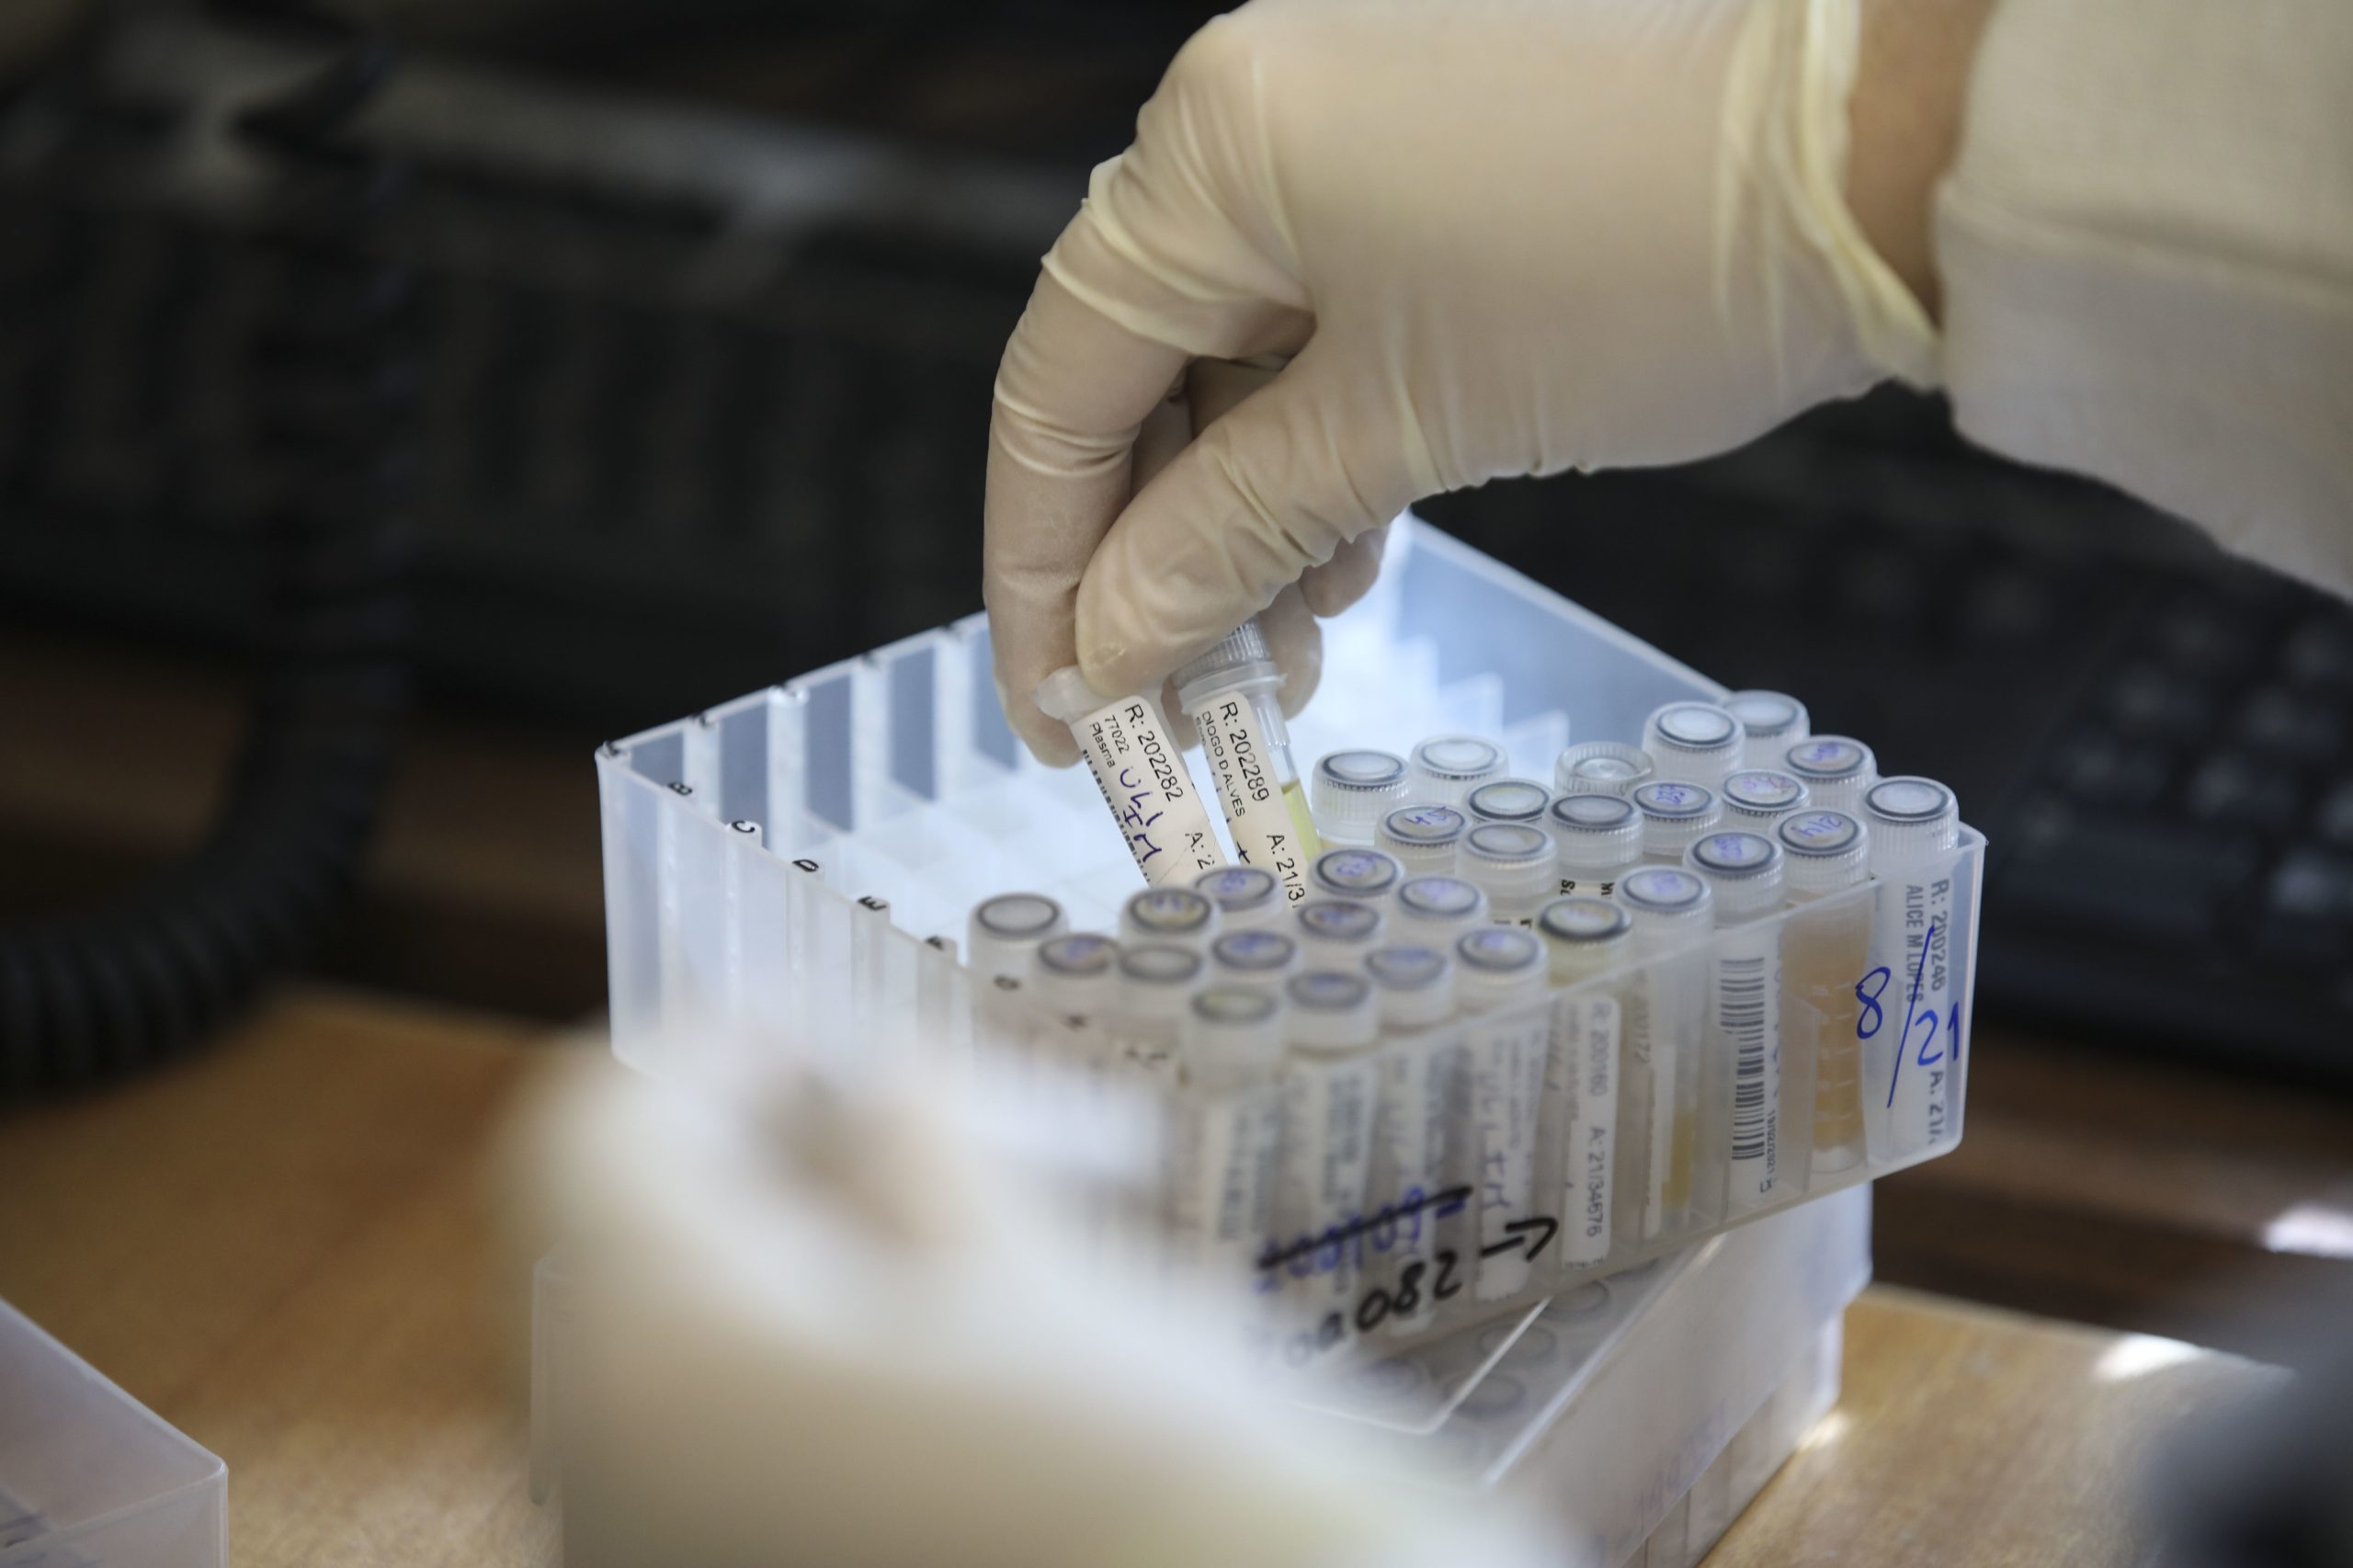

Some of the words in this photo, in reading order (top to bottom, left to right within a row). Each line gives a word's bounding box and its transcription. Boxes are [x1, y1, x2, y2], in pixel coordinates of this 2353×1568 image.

[1089, 722, 1116, 768] Plasma
[1202, 710, 1224, 757] DIOGO
[1125, 704, 1144, 728] R:
[1138, 731, 1184, 801] 202282
[1185, 832, 1204, 852] A:
[1219, 759, 1229, 770] D
[1220, 701, 1238, 726] R:
[1230, 729, 1269, 801] 202289
[1266, 835, 1285, 854] A:
[1276, 858, 1305, 908] 21/3
[1223, 773, 1245, 817] ALVES
[731, 820, 756, 834] C
[791, 858, 820, 872] D
[857, 895, 888, 911] E
[1905, 884, 1924, 928] ALICE
[1906, 934, 1925, 949] M
[1905, 952, 1925, 1003] LOPES
[1855, 926, 1960, 1108] 8/21
